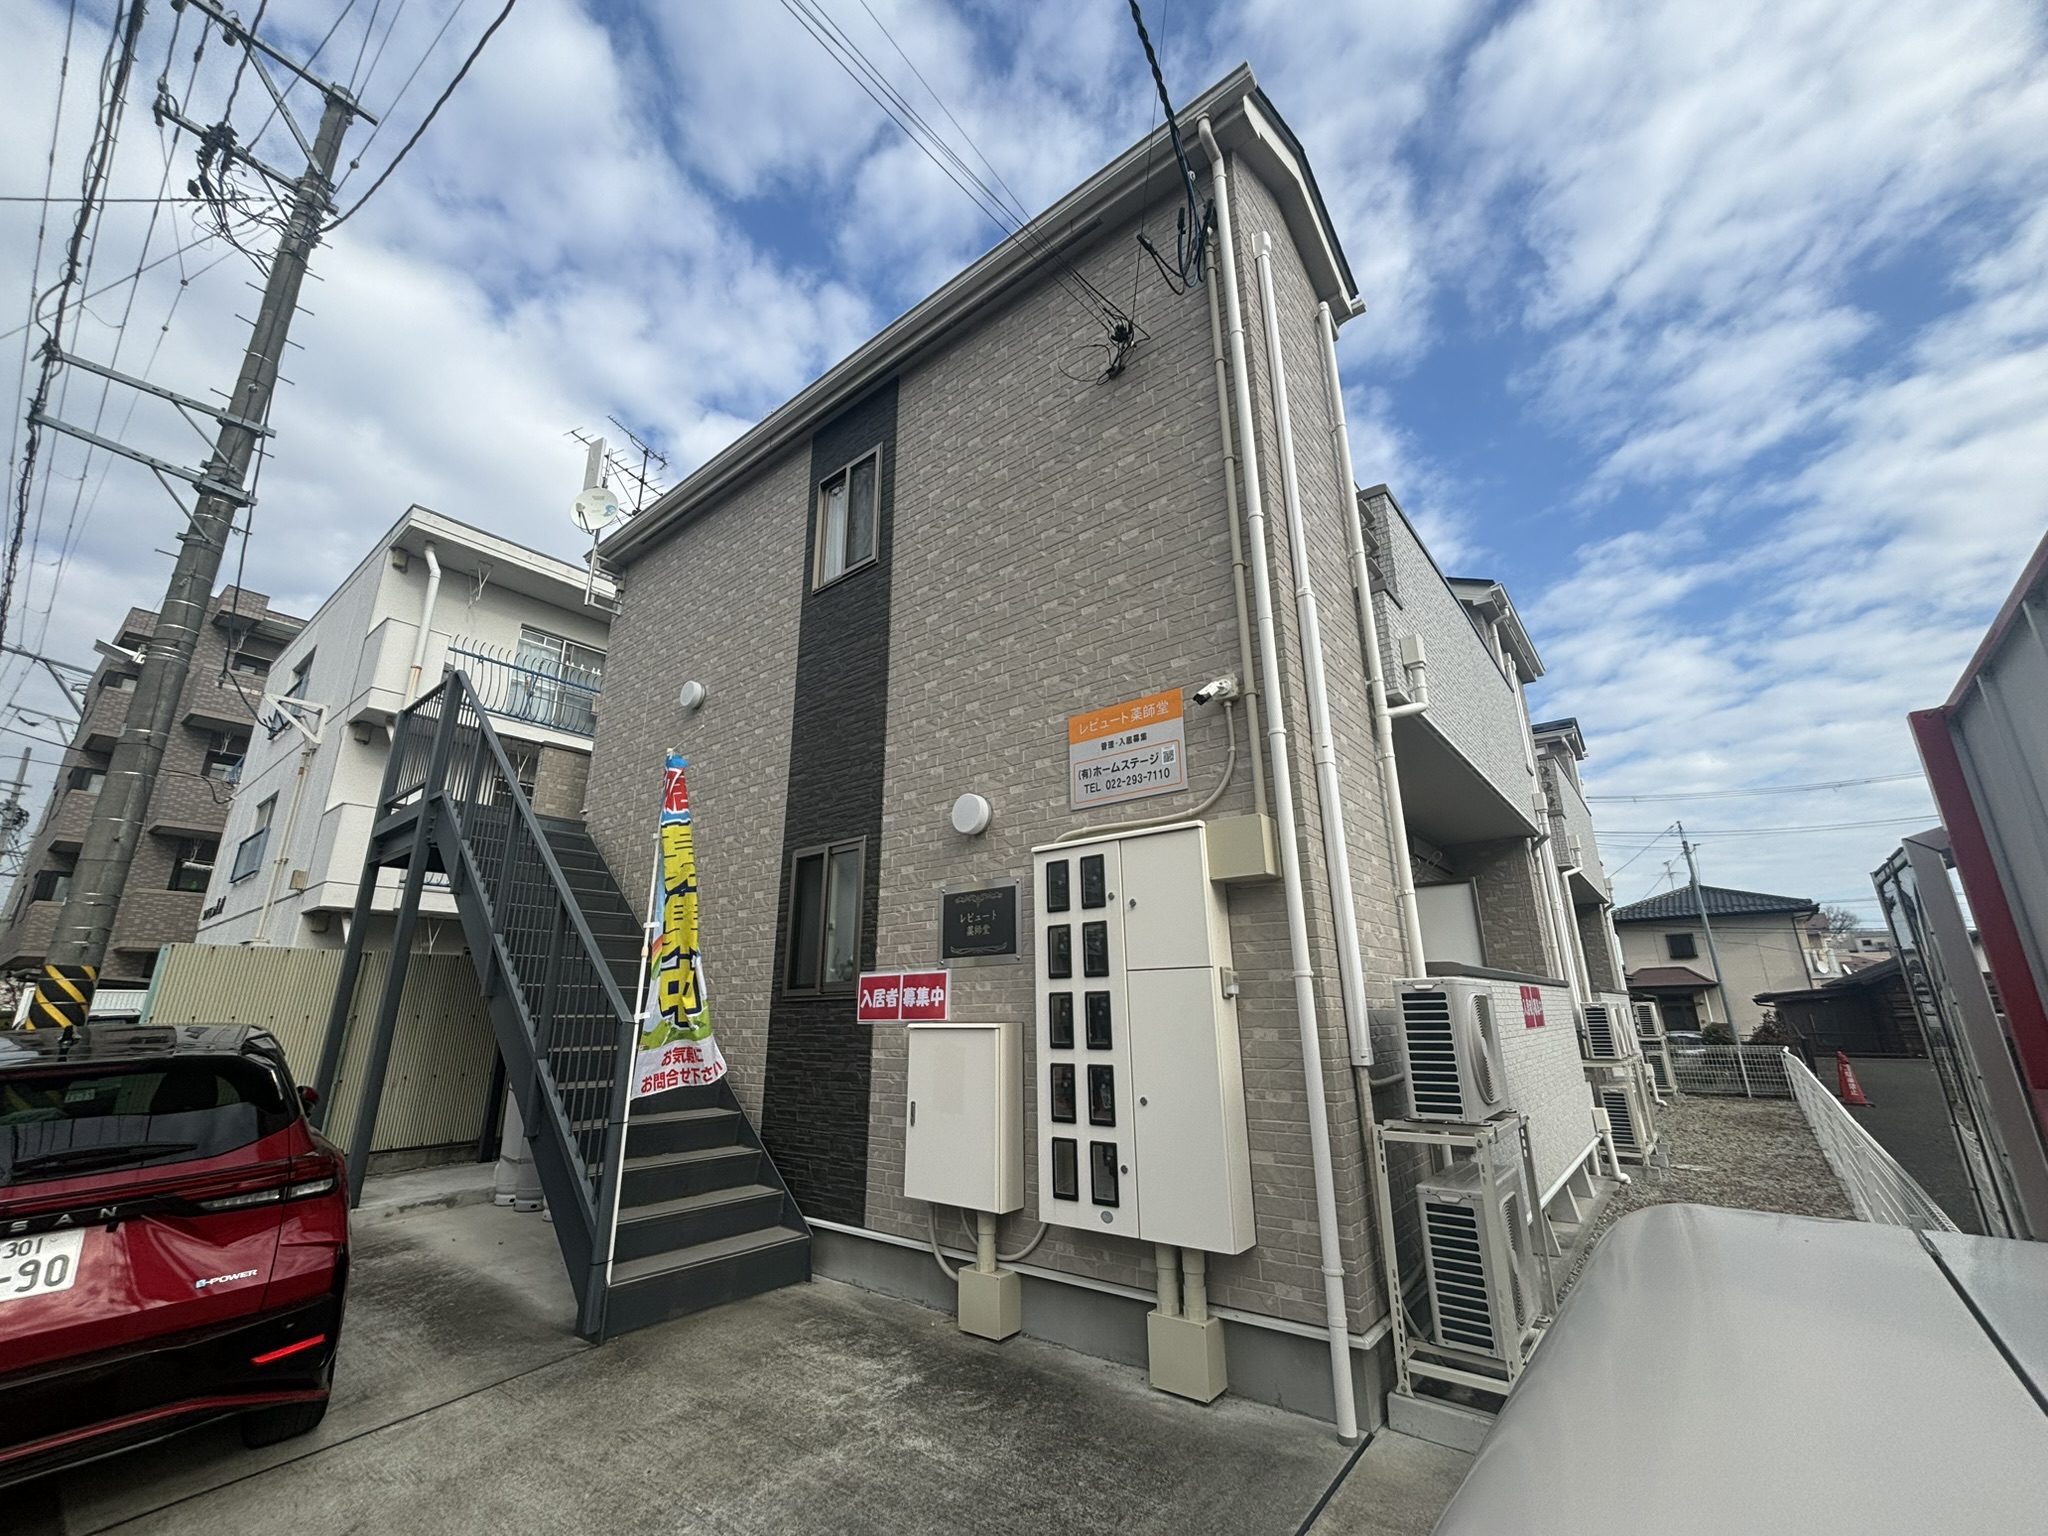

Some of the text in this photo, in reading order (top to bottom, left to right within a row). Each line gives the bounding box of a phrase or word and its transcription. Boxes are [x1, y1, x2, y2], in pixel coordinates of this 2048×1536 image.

[1078, 752, 1159, 780] (有)ホームステージ
[1084, 767, 1170, 794] TEL 022-293-7110
[661, 1046, 704, 1067] お気軽に
[641, 1061, 723, 1093] お問合せ下さい
